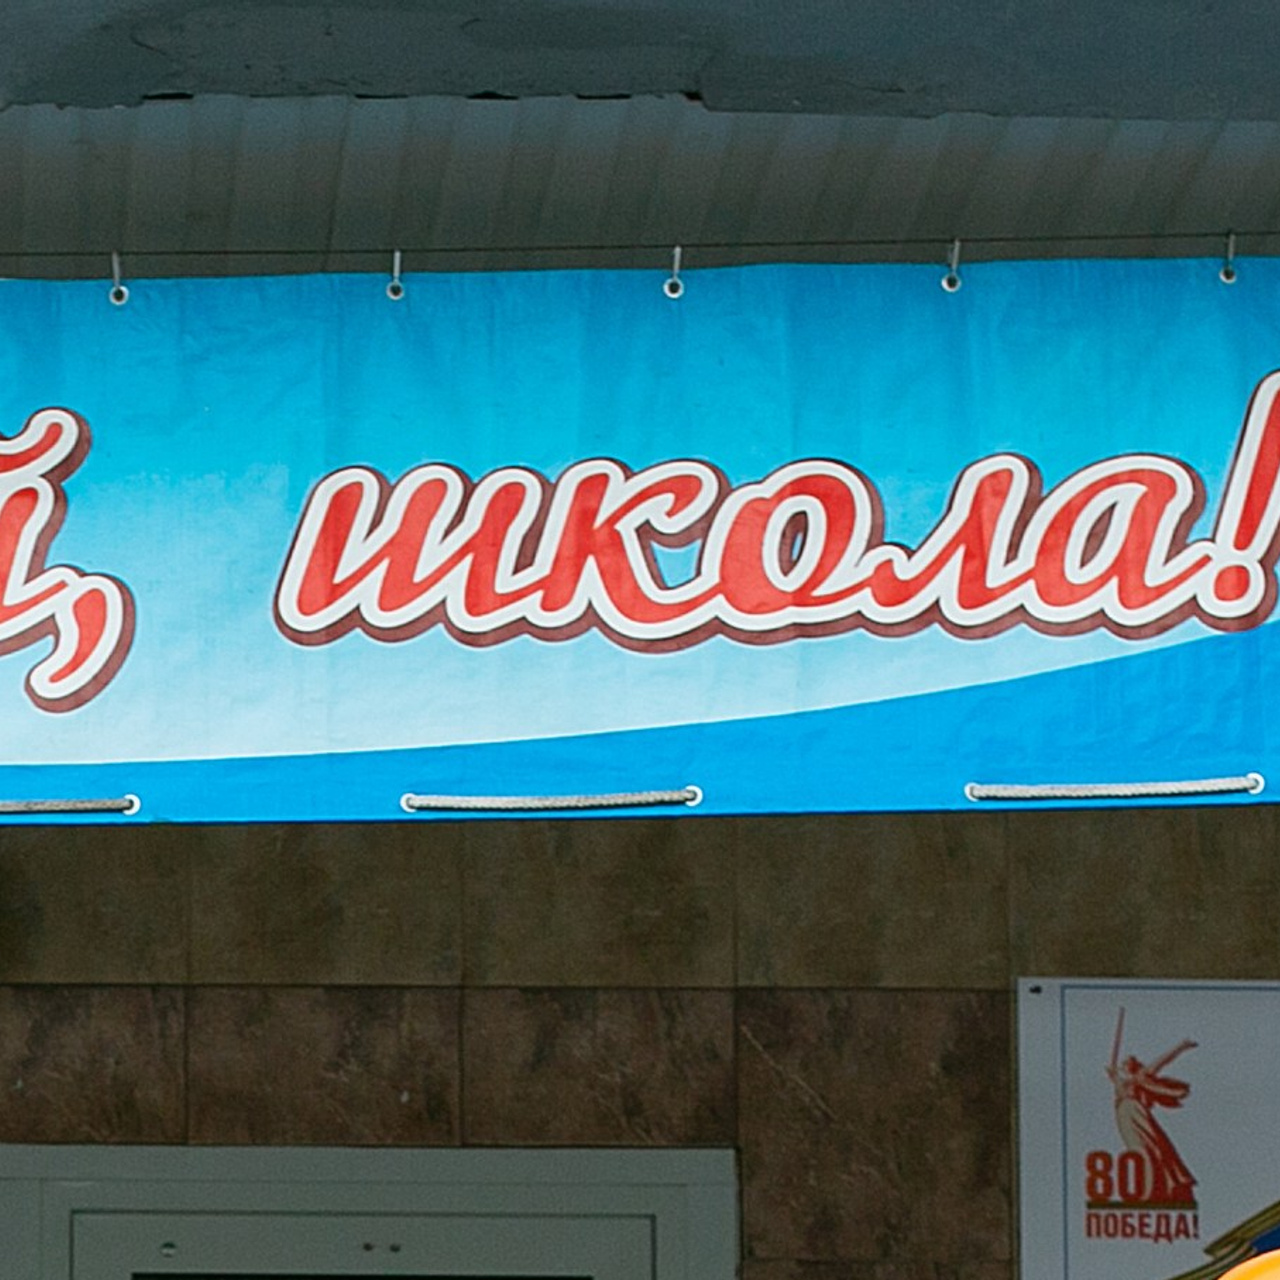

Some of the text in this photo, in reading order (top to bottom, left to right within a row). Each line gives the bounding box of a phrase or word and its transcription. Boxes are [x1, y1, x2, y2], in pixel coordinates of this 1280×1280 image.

[273, 367, 1280, 654] школа!
[1085, 1150, 1145, 1202] 80
[1085, 1211, 1200, 1244] ПОБЕДА!
